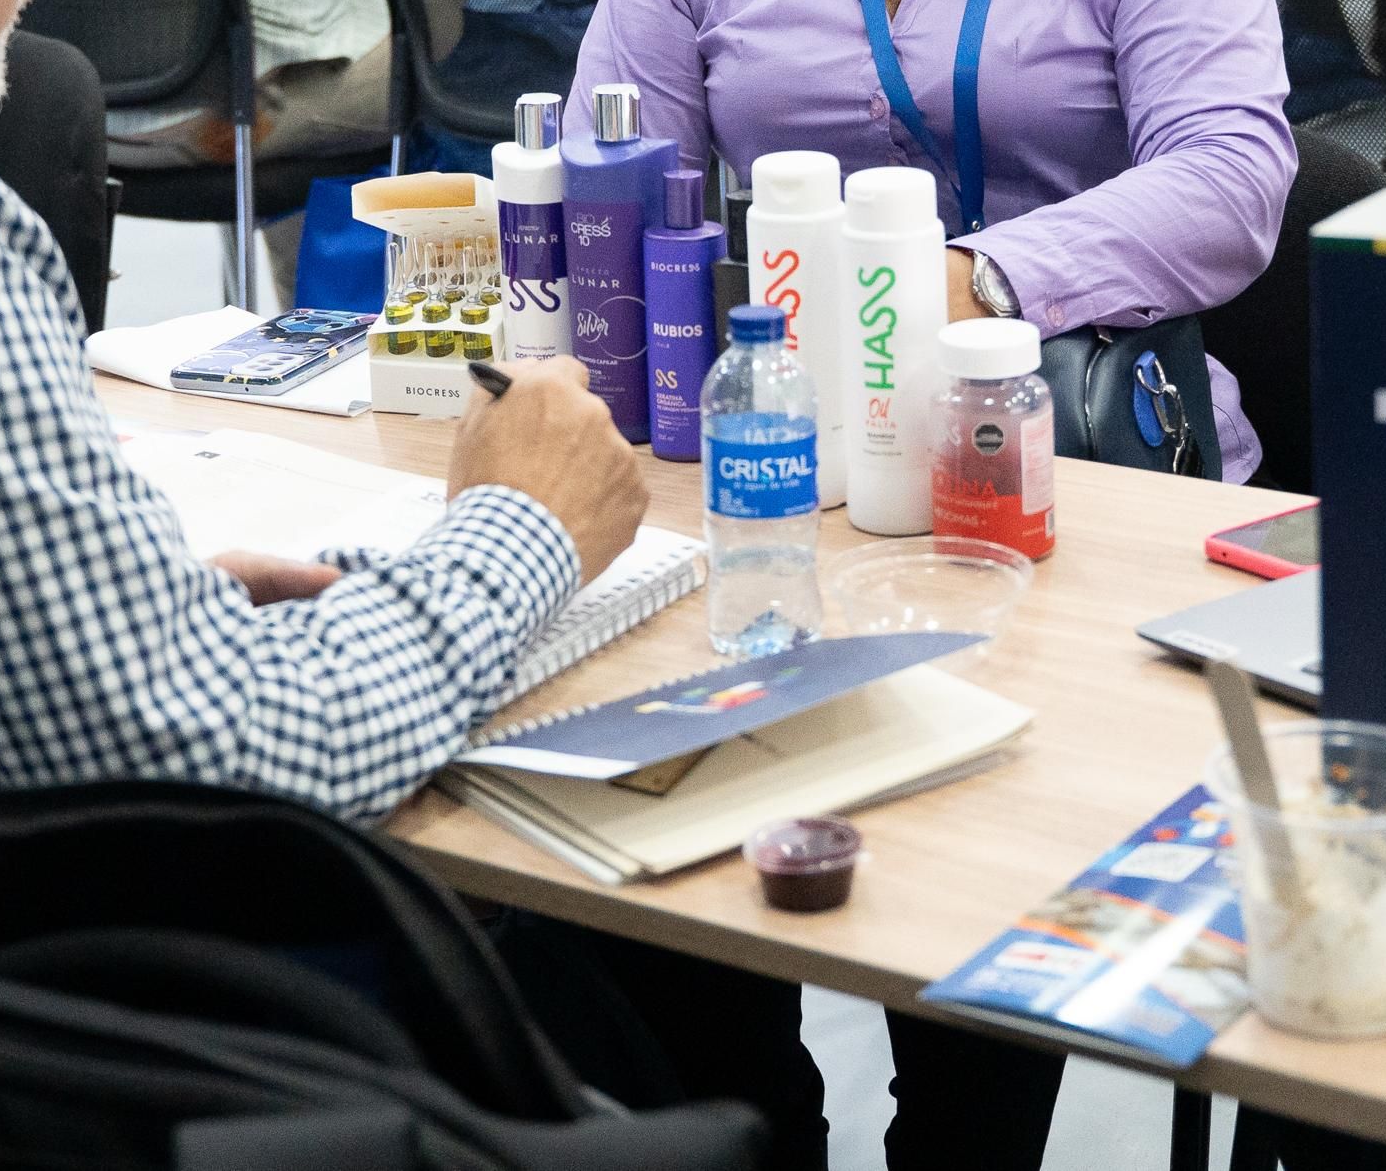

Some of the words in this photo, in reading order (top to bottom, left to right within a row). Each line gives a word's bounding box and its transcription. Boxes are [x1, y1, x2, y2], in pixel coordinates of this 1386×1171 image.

[504, 232, 558, 245] LUNAR
[578, 234, 590, 247] 10
[572, 274, 620, 289] LUNAR
[653, 322, 703, 338] RUBIOS
[858, 265, 897, 390] HASS
[405, 386, 460, 398] BIOCRESS
[719, 453, 813, 482] CRISTAL
